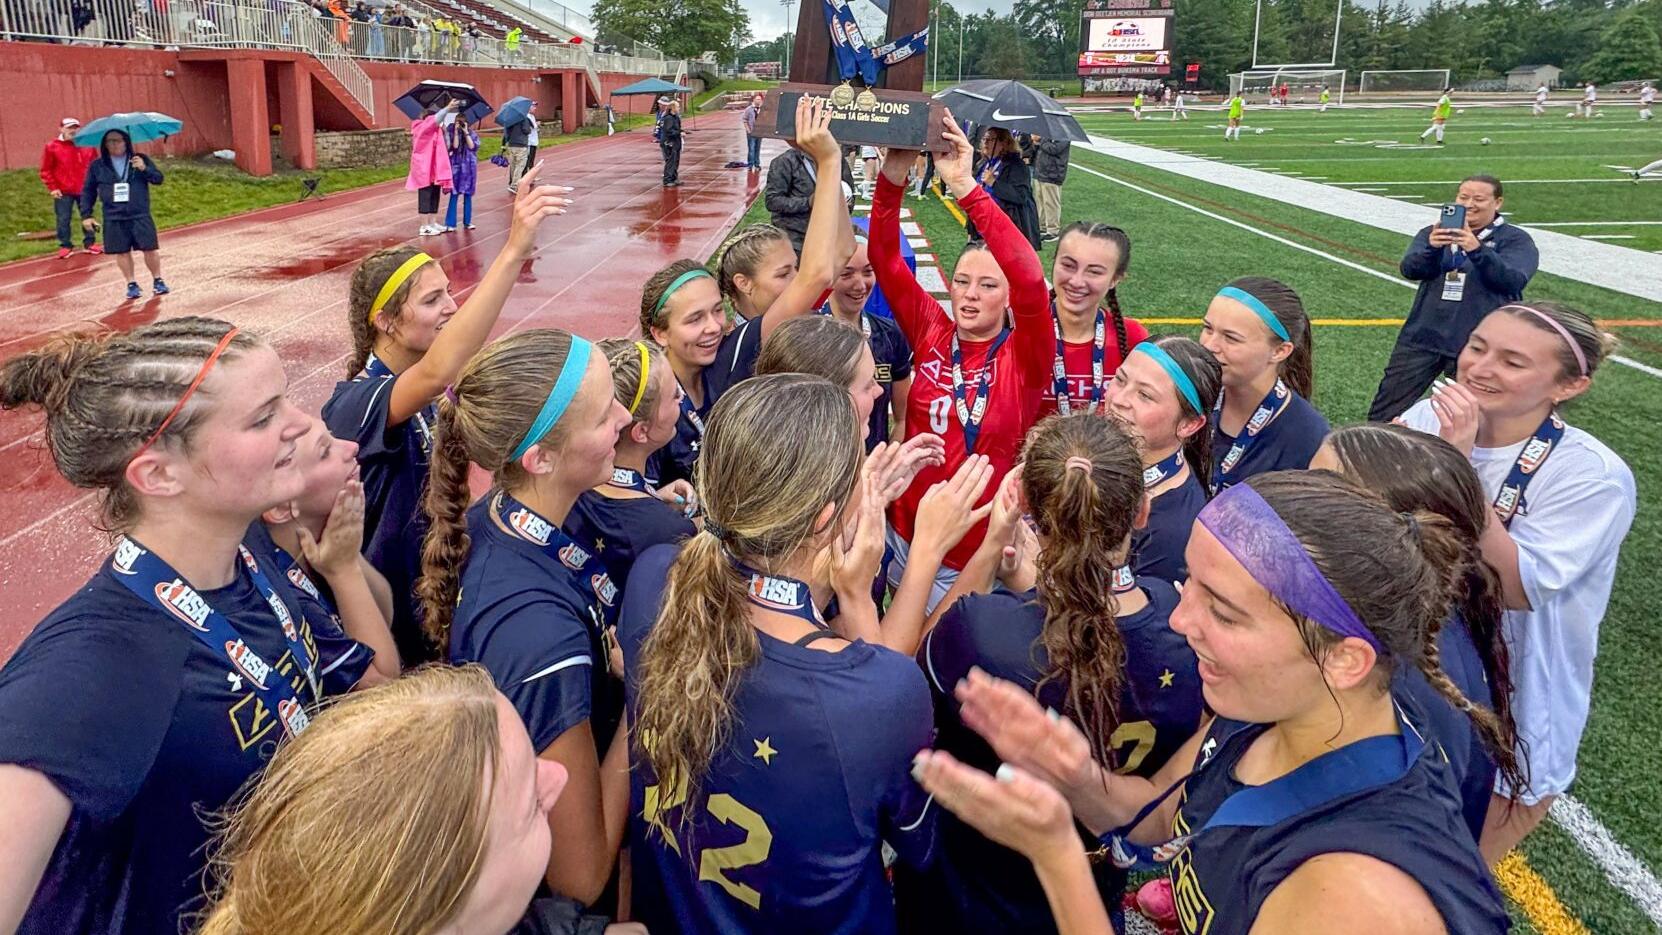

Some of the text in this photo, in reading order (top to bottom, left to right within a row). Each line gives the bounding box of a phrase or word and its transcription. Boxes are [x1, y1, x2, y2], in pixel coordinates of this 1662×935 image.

[857, 112, 870, 121] Girls
[871, 113, 890, 122] Soccer
[929, 395, 952, 435] 0
[159, 577, 211, 627] IHSA
[749, 573, 798, 606] IHSA
[230, 637, 270, 686] IHSA
